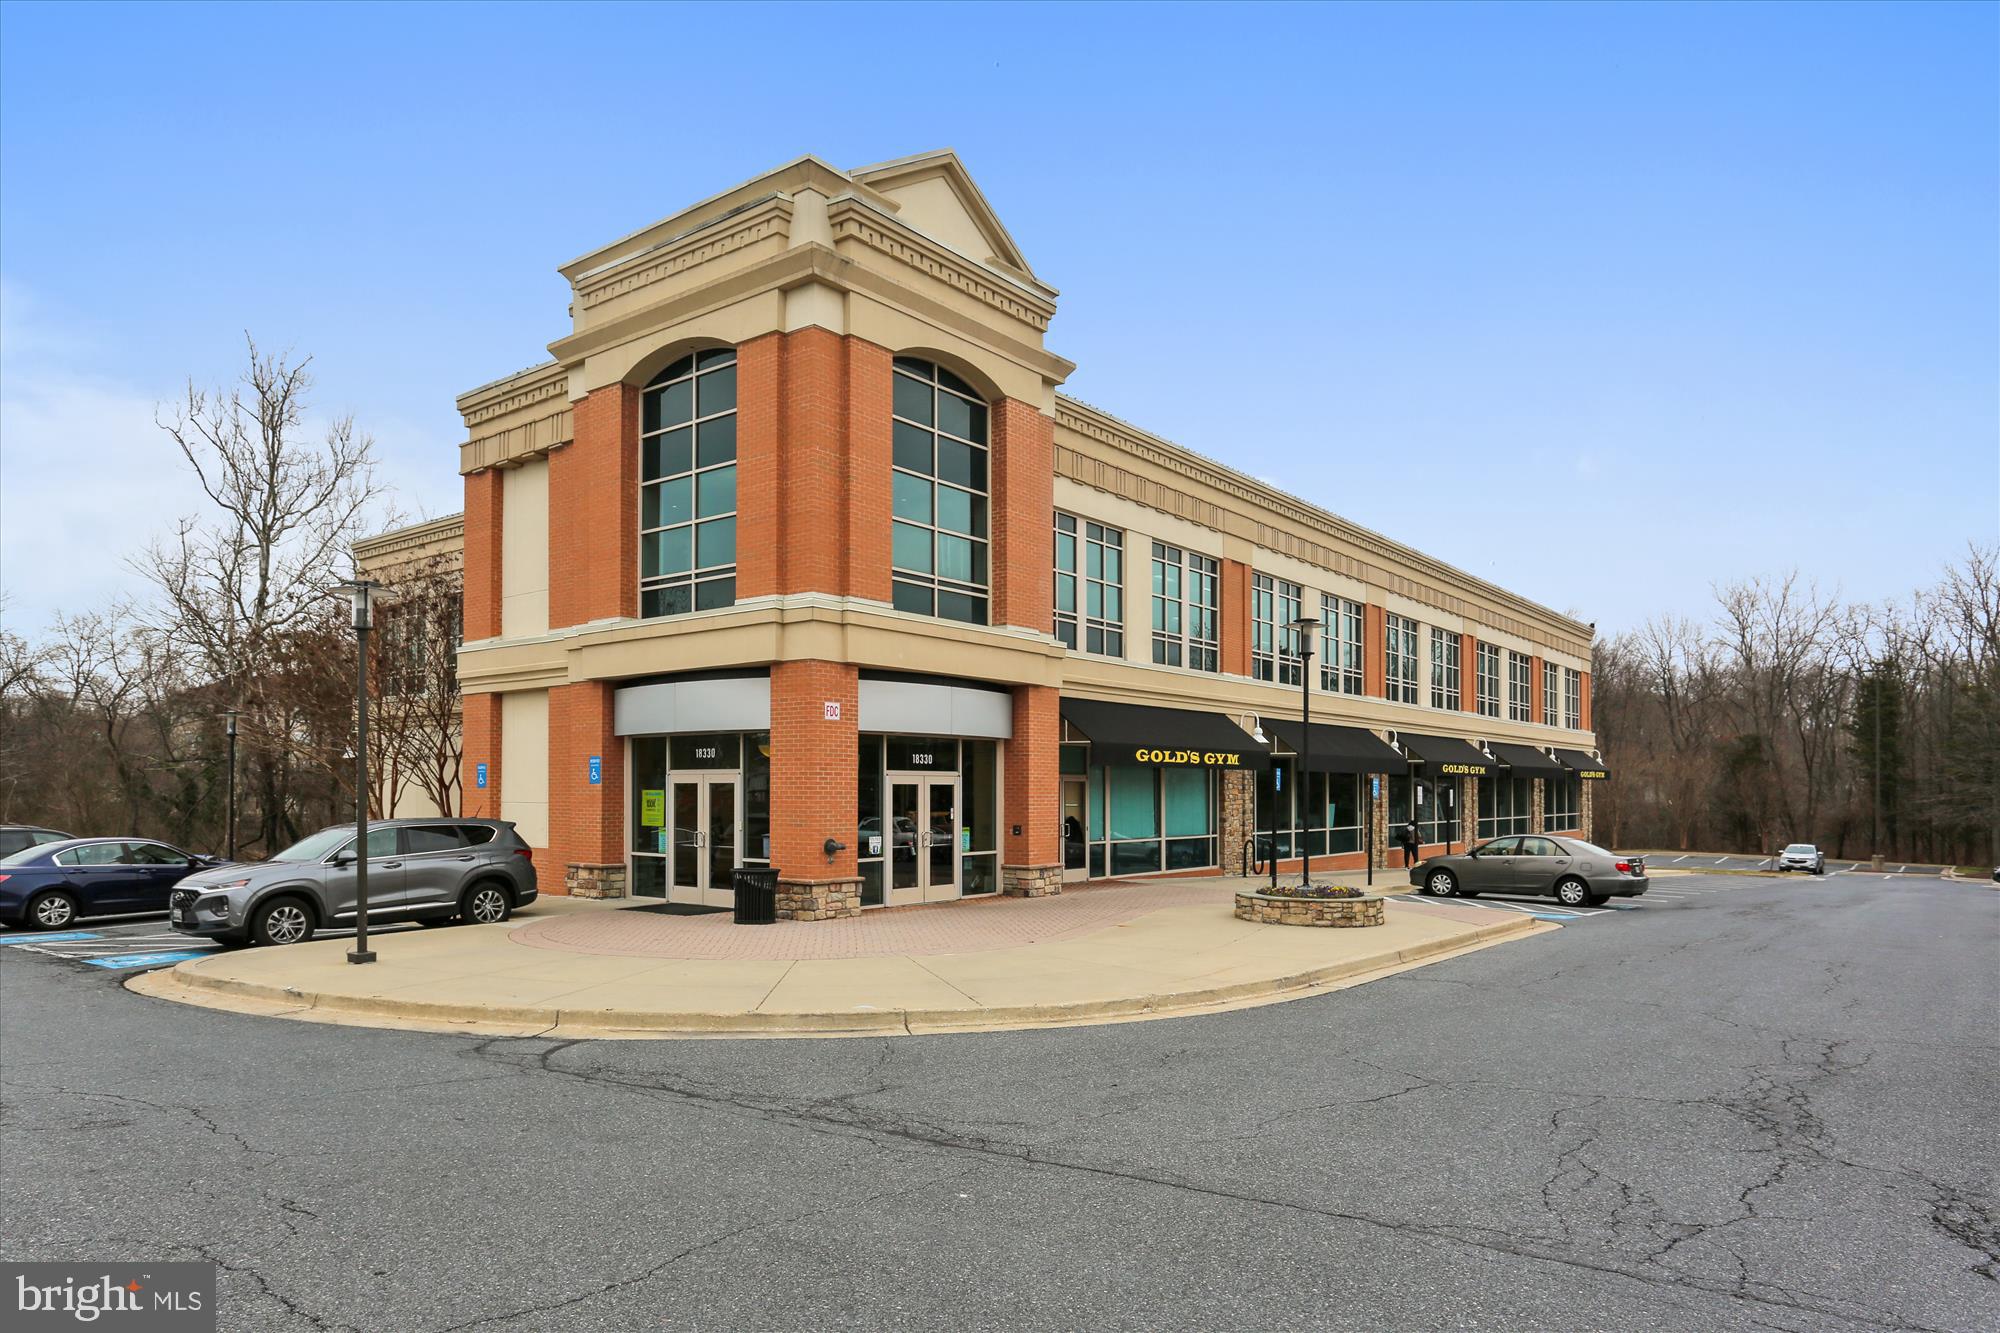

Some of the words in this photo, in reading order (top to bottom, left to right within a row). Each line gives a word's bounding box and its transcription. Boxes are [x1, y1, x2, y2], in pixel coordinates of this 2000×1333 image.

[825, 705, 839, 717] FDC
[695, 748, 716, 759] 18330
[912, 753, 933, 765] 18330
[1135, 749, 1200, 764] GOLD'S
[1204, 753, 1240, 765] GYM
[1442, 764, 1469, 774] GOLD'S
[1470, 766, 1486, 775] GYM
